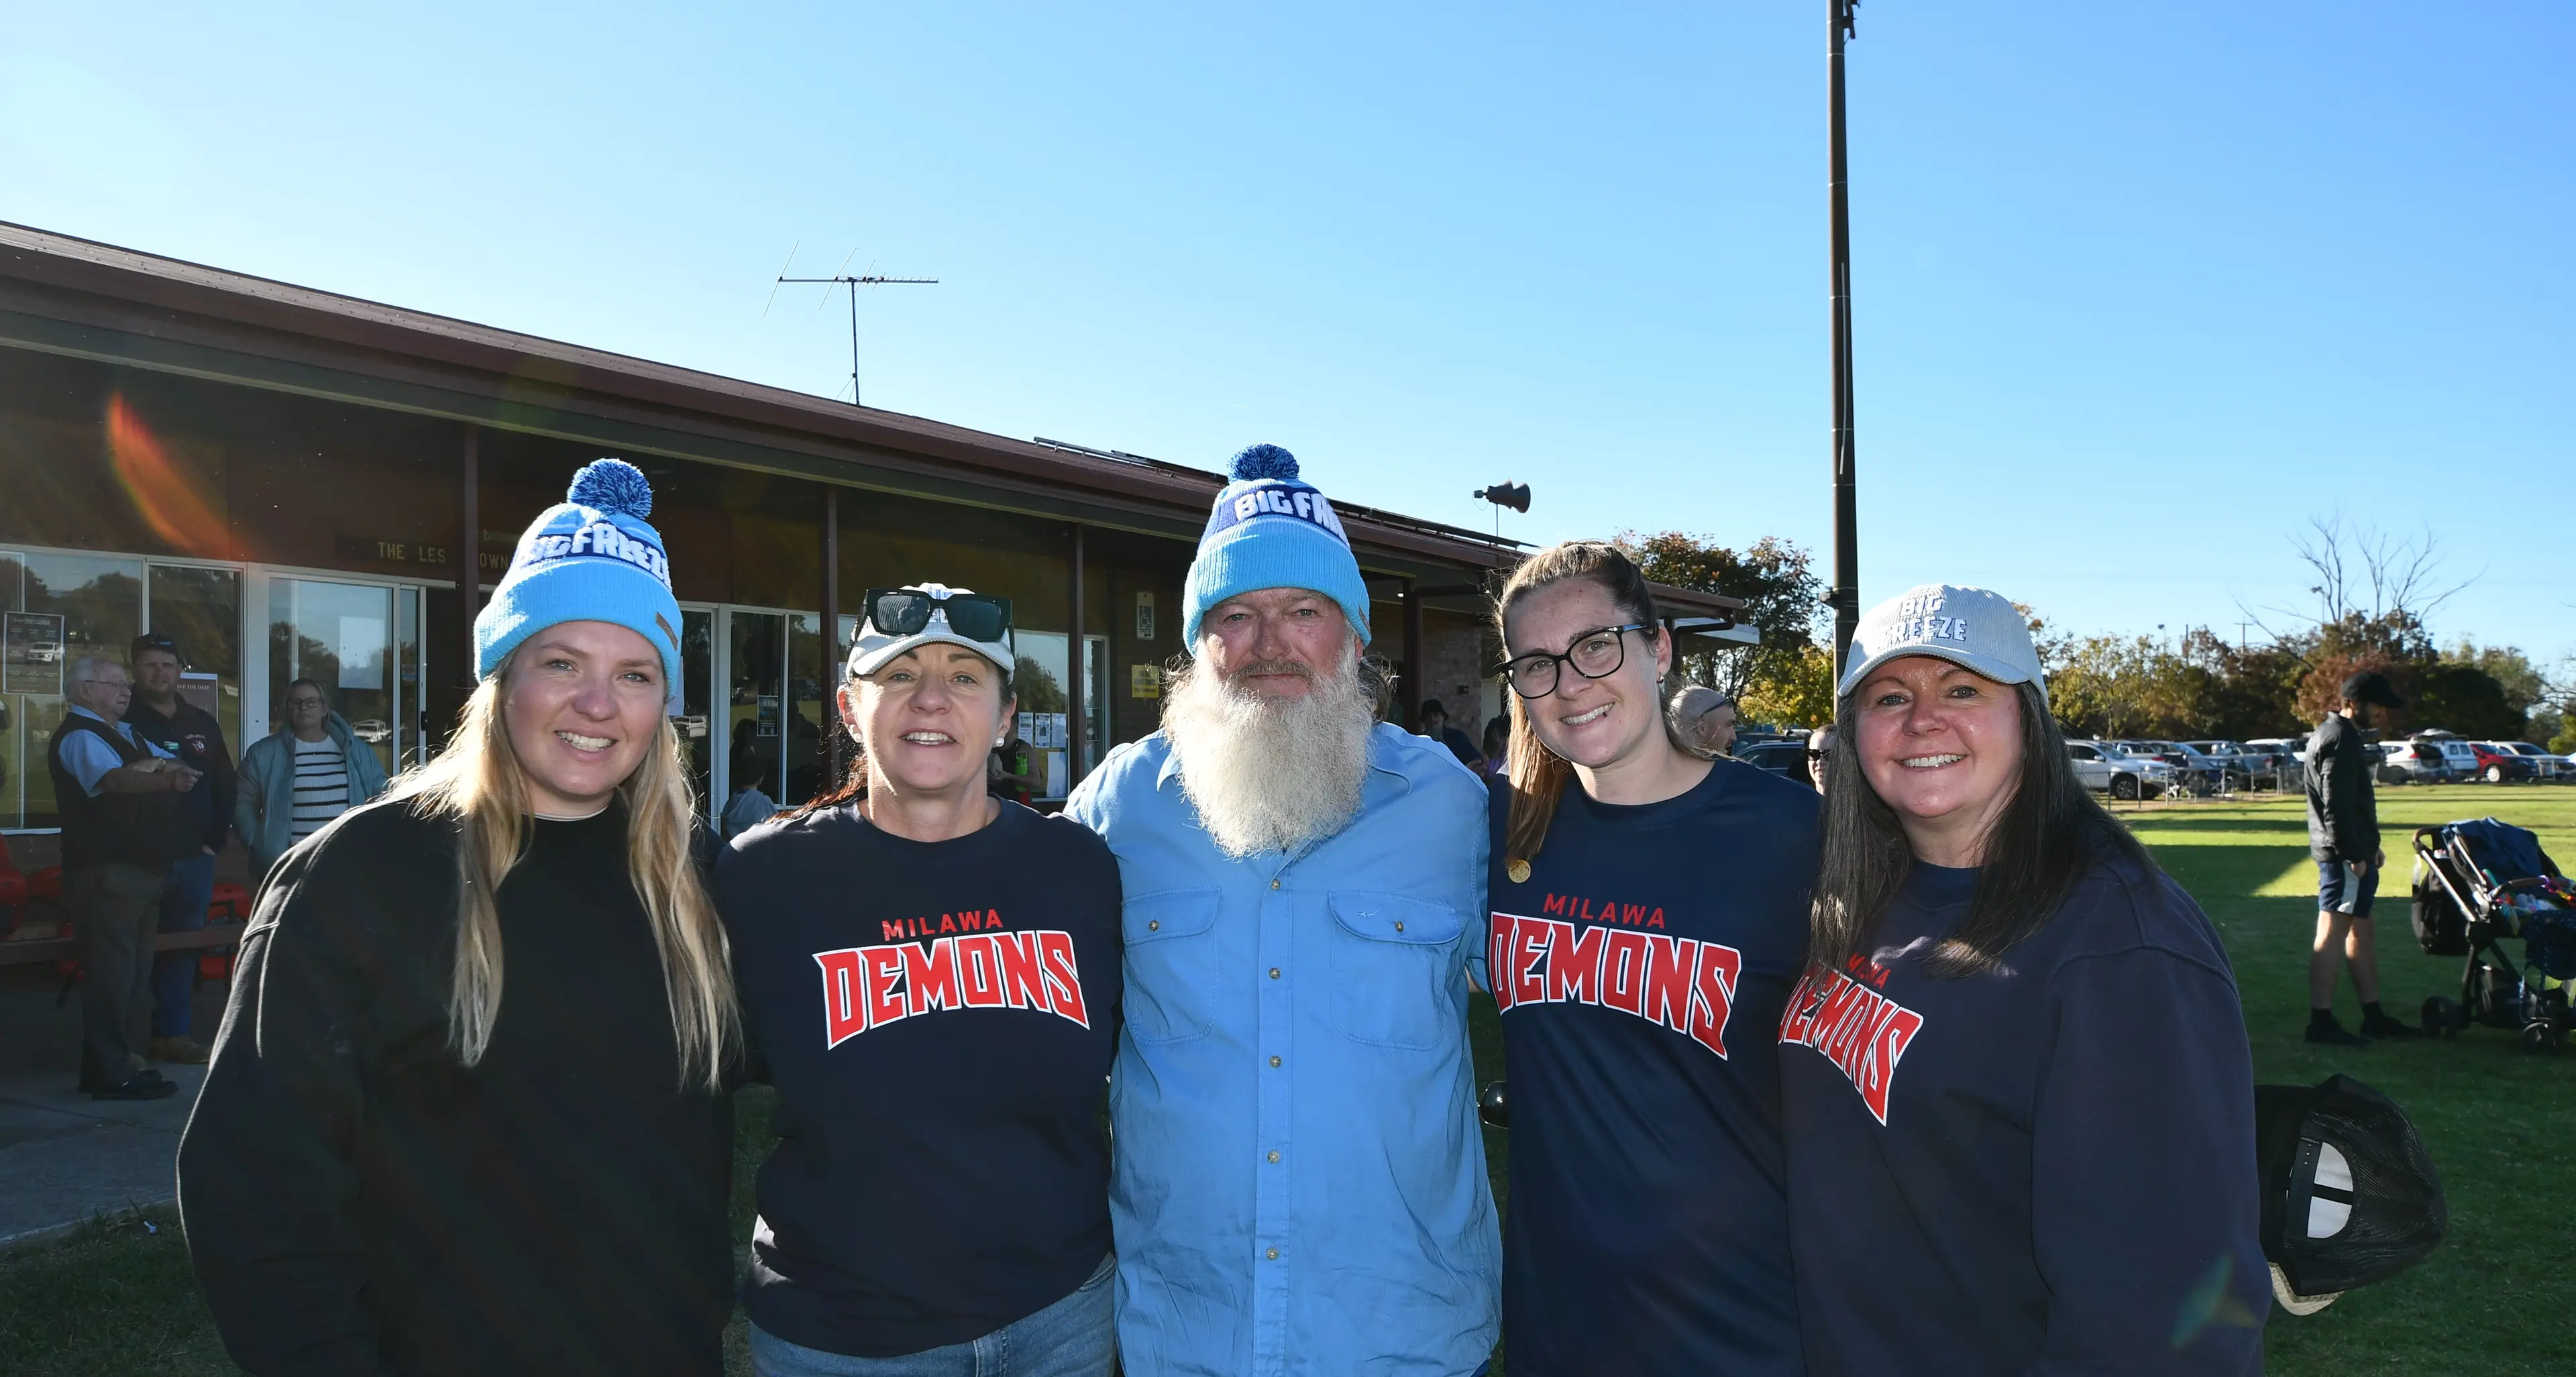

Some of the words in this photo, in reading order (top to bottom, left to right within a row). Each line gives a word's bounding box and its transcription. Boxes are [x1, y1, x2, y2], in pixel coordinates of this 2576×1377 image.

[1235, 490, 1293, 520] BIG
[378, 542, 405, 560] THE
[419, 547, 445, 563] LES
[479, 553, 508, 569] OWN
[522, 535, 572, 565] IG
[1899, 594, 1945, 616] BIG
[881, 908, 1003, 941] MILAWA
[1543, 893, 1665, 929] MILAWA
[812, 930, 1090, 1050] DEMONS
[1488, 912, 1741, 1061] DEMONS
